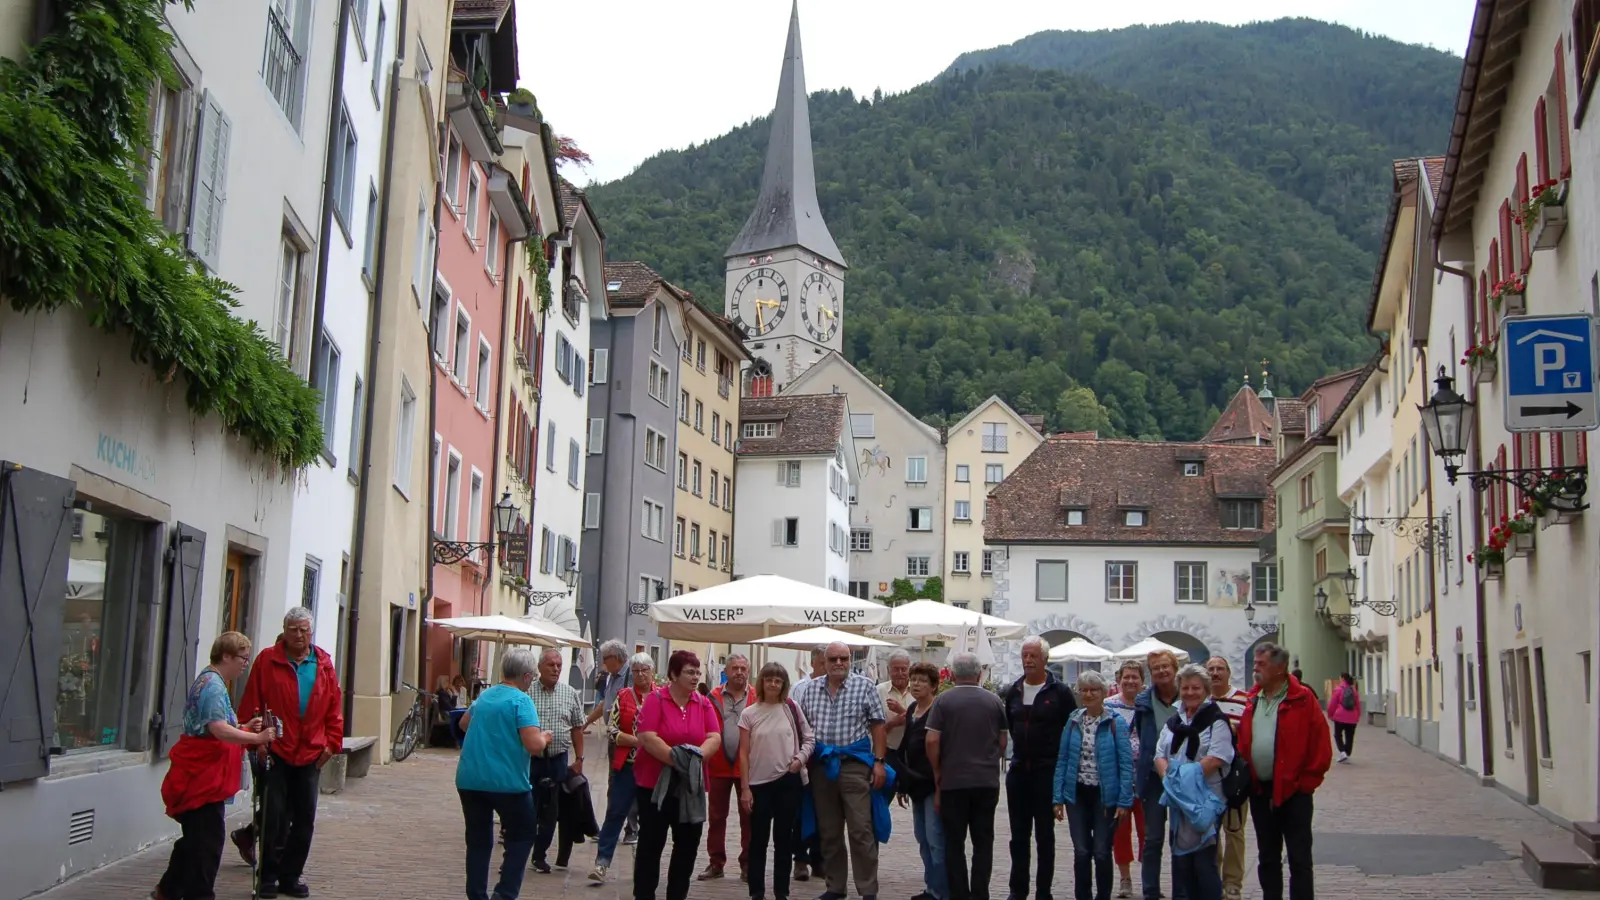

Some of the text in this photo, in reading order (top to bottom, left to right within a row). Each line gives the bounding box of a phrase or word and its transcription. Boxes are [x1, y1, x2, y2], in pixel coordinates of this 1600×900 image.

[1534, 342, 1566, 387] P
[683, 608, 735, 621] VALSER
[804, 609, 857, 623] VALSER
